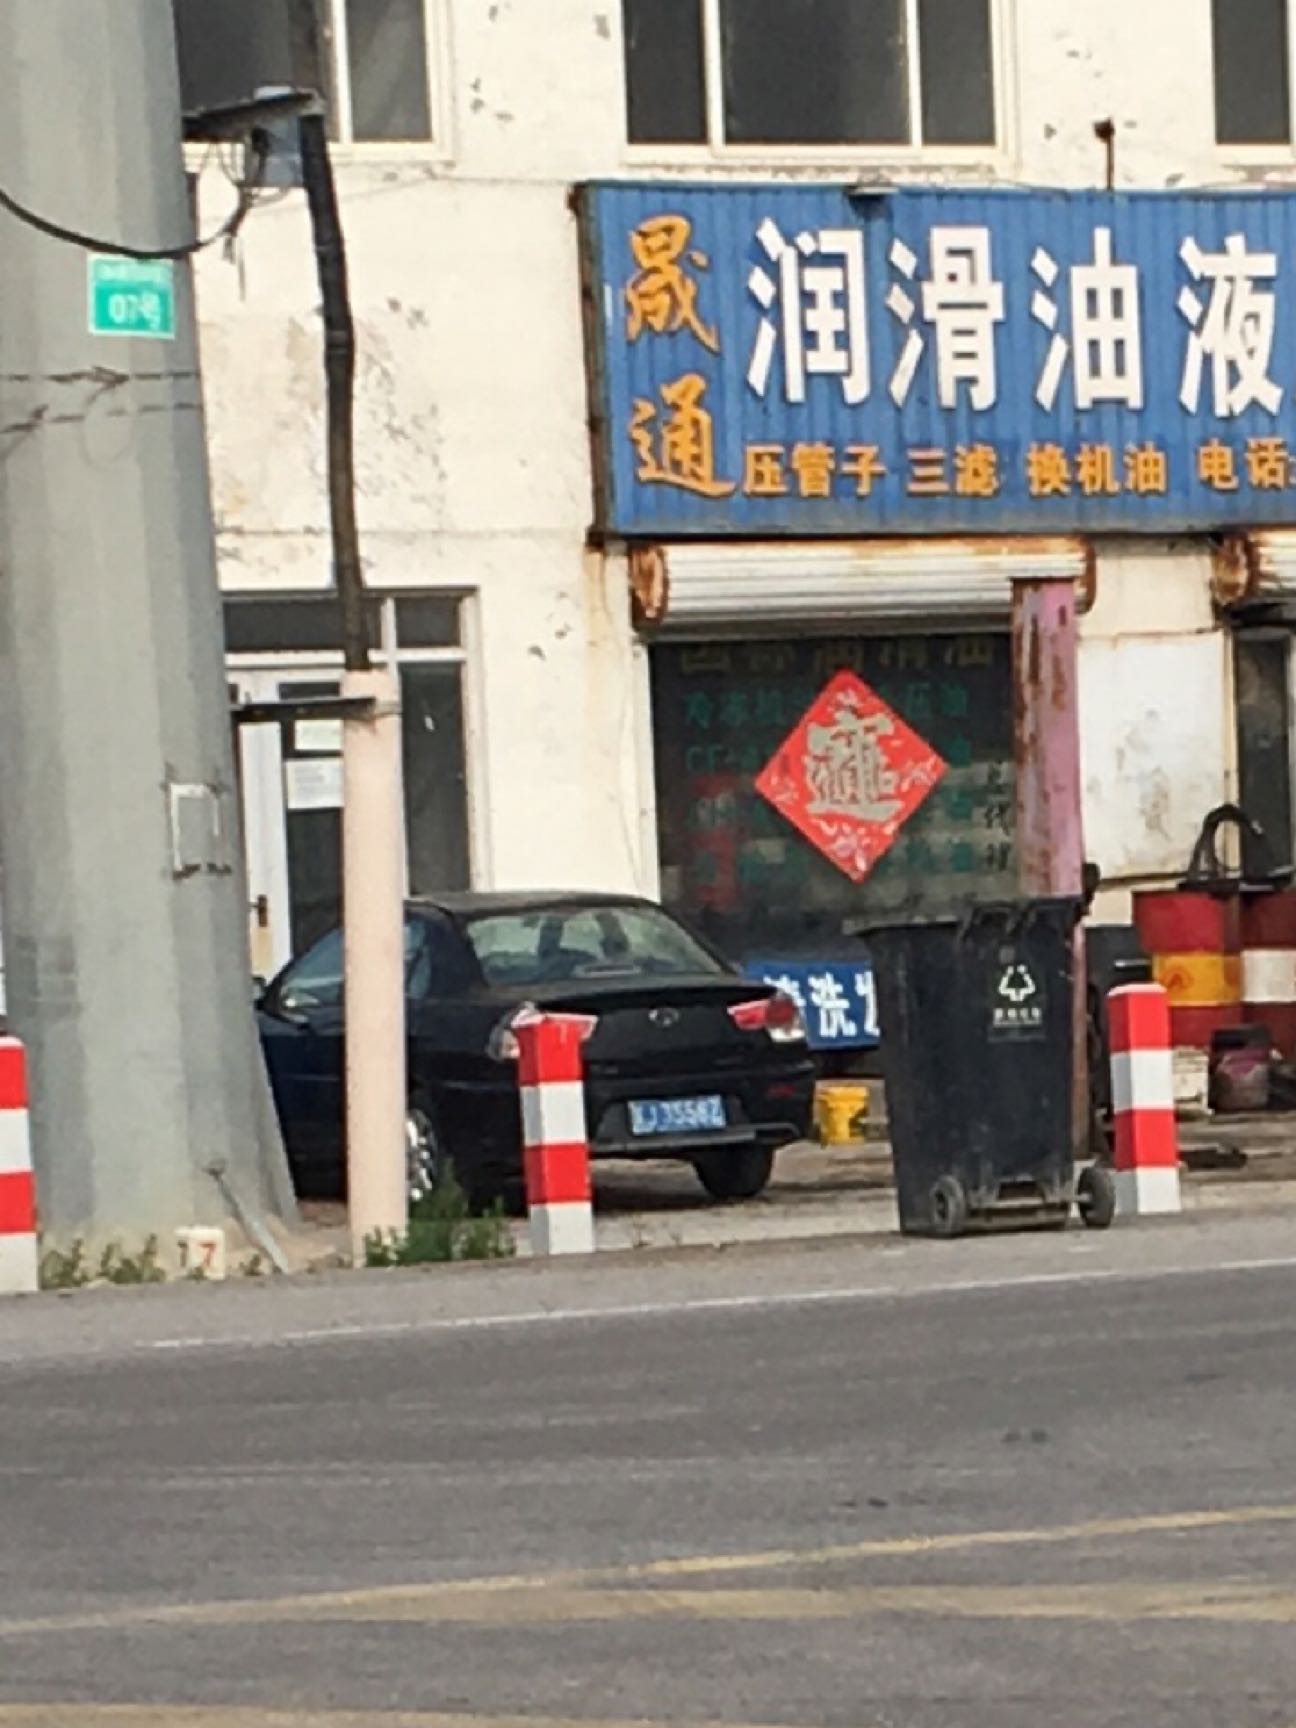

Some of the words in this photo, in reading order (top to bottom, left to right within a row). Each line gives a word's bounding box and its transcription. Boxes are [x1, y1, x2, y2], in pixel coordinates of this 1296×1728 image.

[625, 215, 737, 498] 晟通
[741, 442, 886, 496] 压管子
[906, 444, 999, 496] 三滤
[1025, 440, 1168, 495] 换机油
